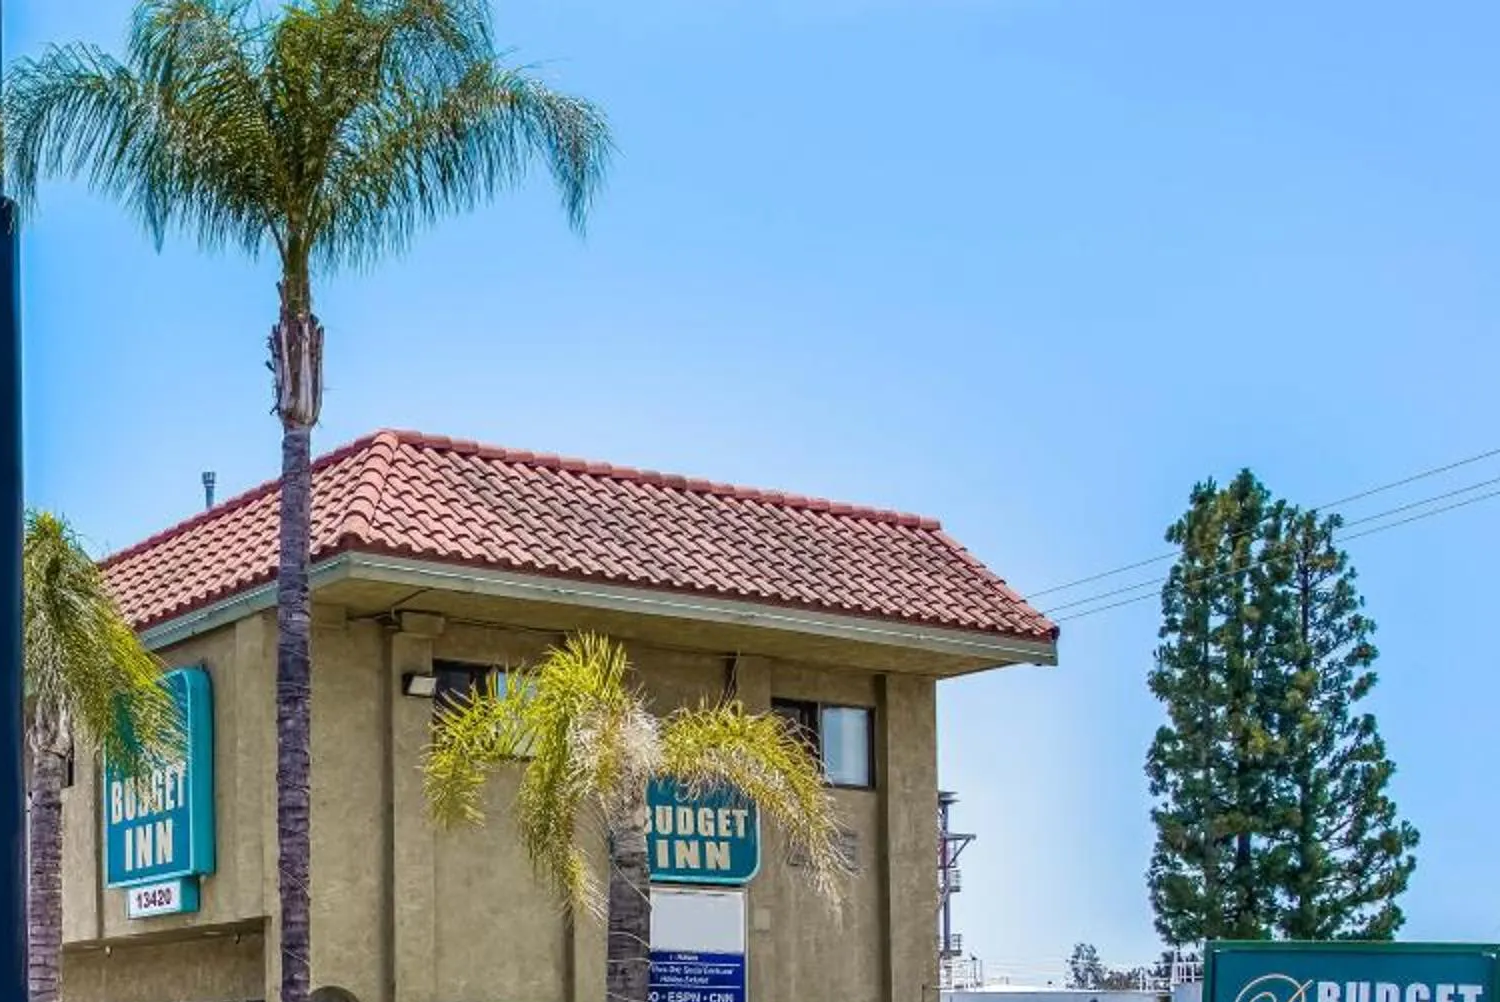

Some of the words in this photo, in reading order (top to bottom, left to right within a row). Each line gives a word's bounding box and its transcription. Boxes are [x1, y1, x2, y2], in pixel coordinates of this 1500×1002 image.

[111, 761, 186, 825] BUDGET
[125, 818, 173, 872] INN
[656, 839, 731, 870] INN
[136, 887, 172, 910] 13420
[667, 991, 700, 1002] ESPN
